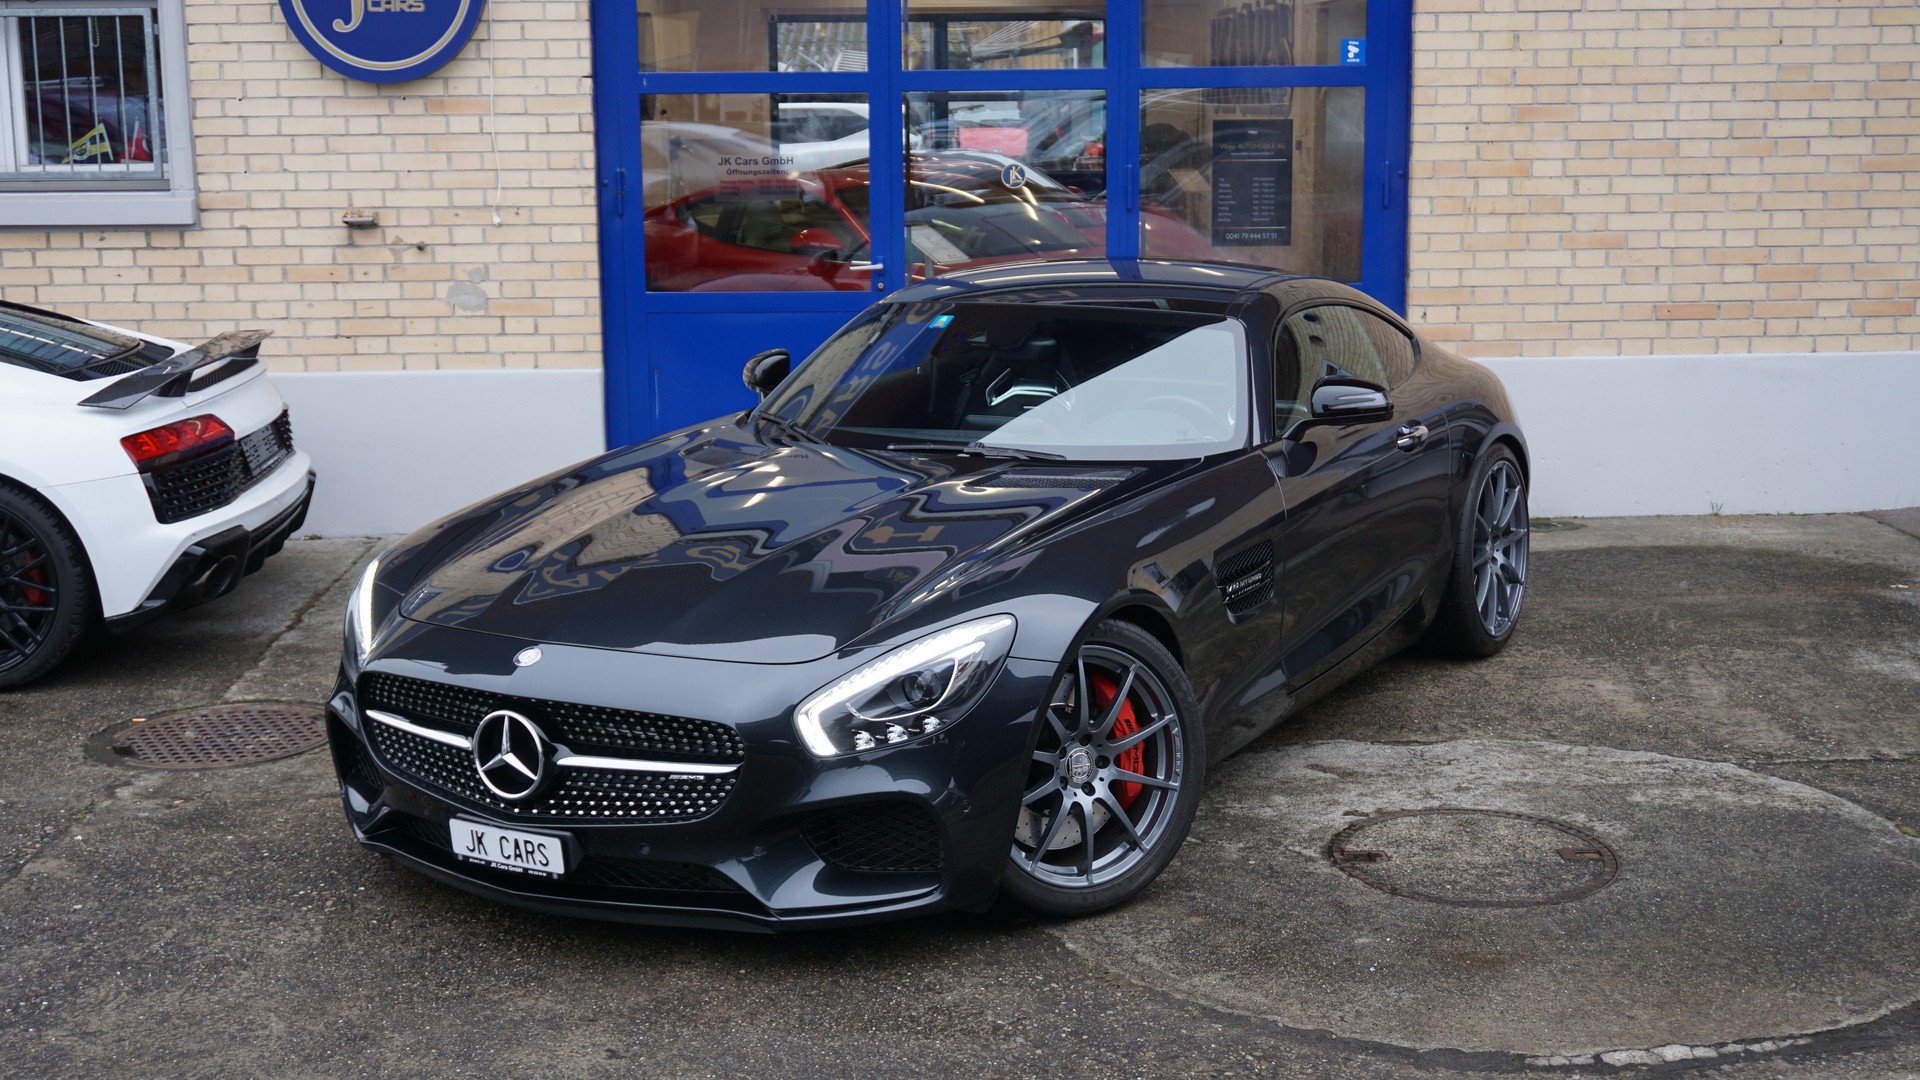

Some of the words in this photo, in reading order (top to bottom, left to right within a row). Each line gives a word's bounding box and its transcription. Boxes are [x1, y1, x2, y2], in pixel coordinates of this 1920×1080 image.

[367, 0, 425, 12] CARS
[718, 157, 732, 166] JK
[735, 156, 758, 166] Cars
[761, 156, 794, 165] GmbH
[726, 168, 788, 176] Öffnungszeiten:
[1225, 232, 1240, 240] 0041
[1241, 232, 1249, 240] 79
[1250, 232, 1261, 240] 944
[466, 829, 488, 857] JK
[499, 835, 549, 867] CARS
